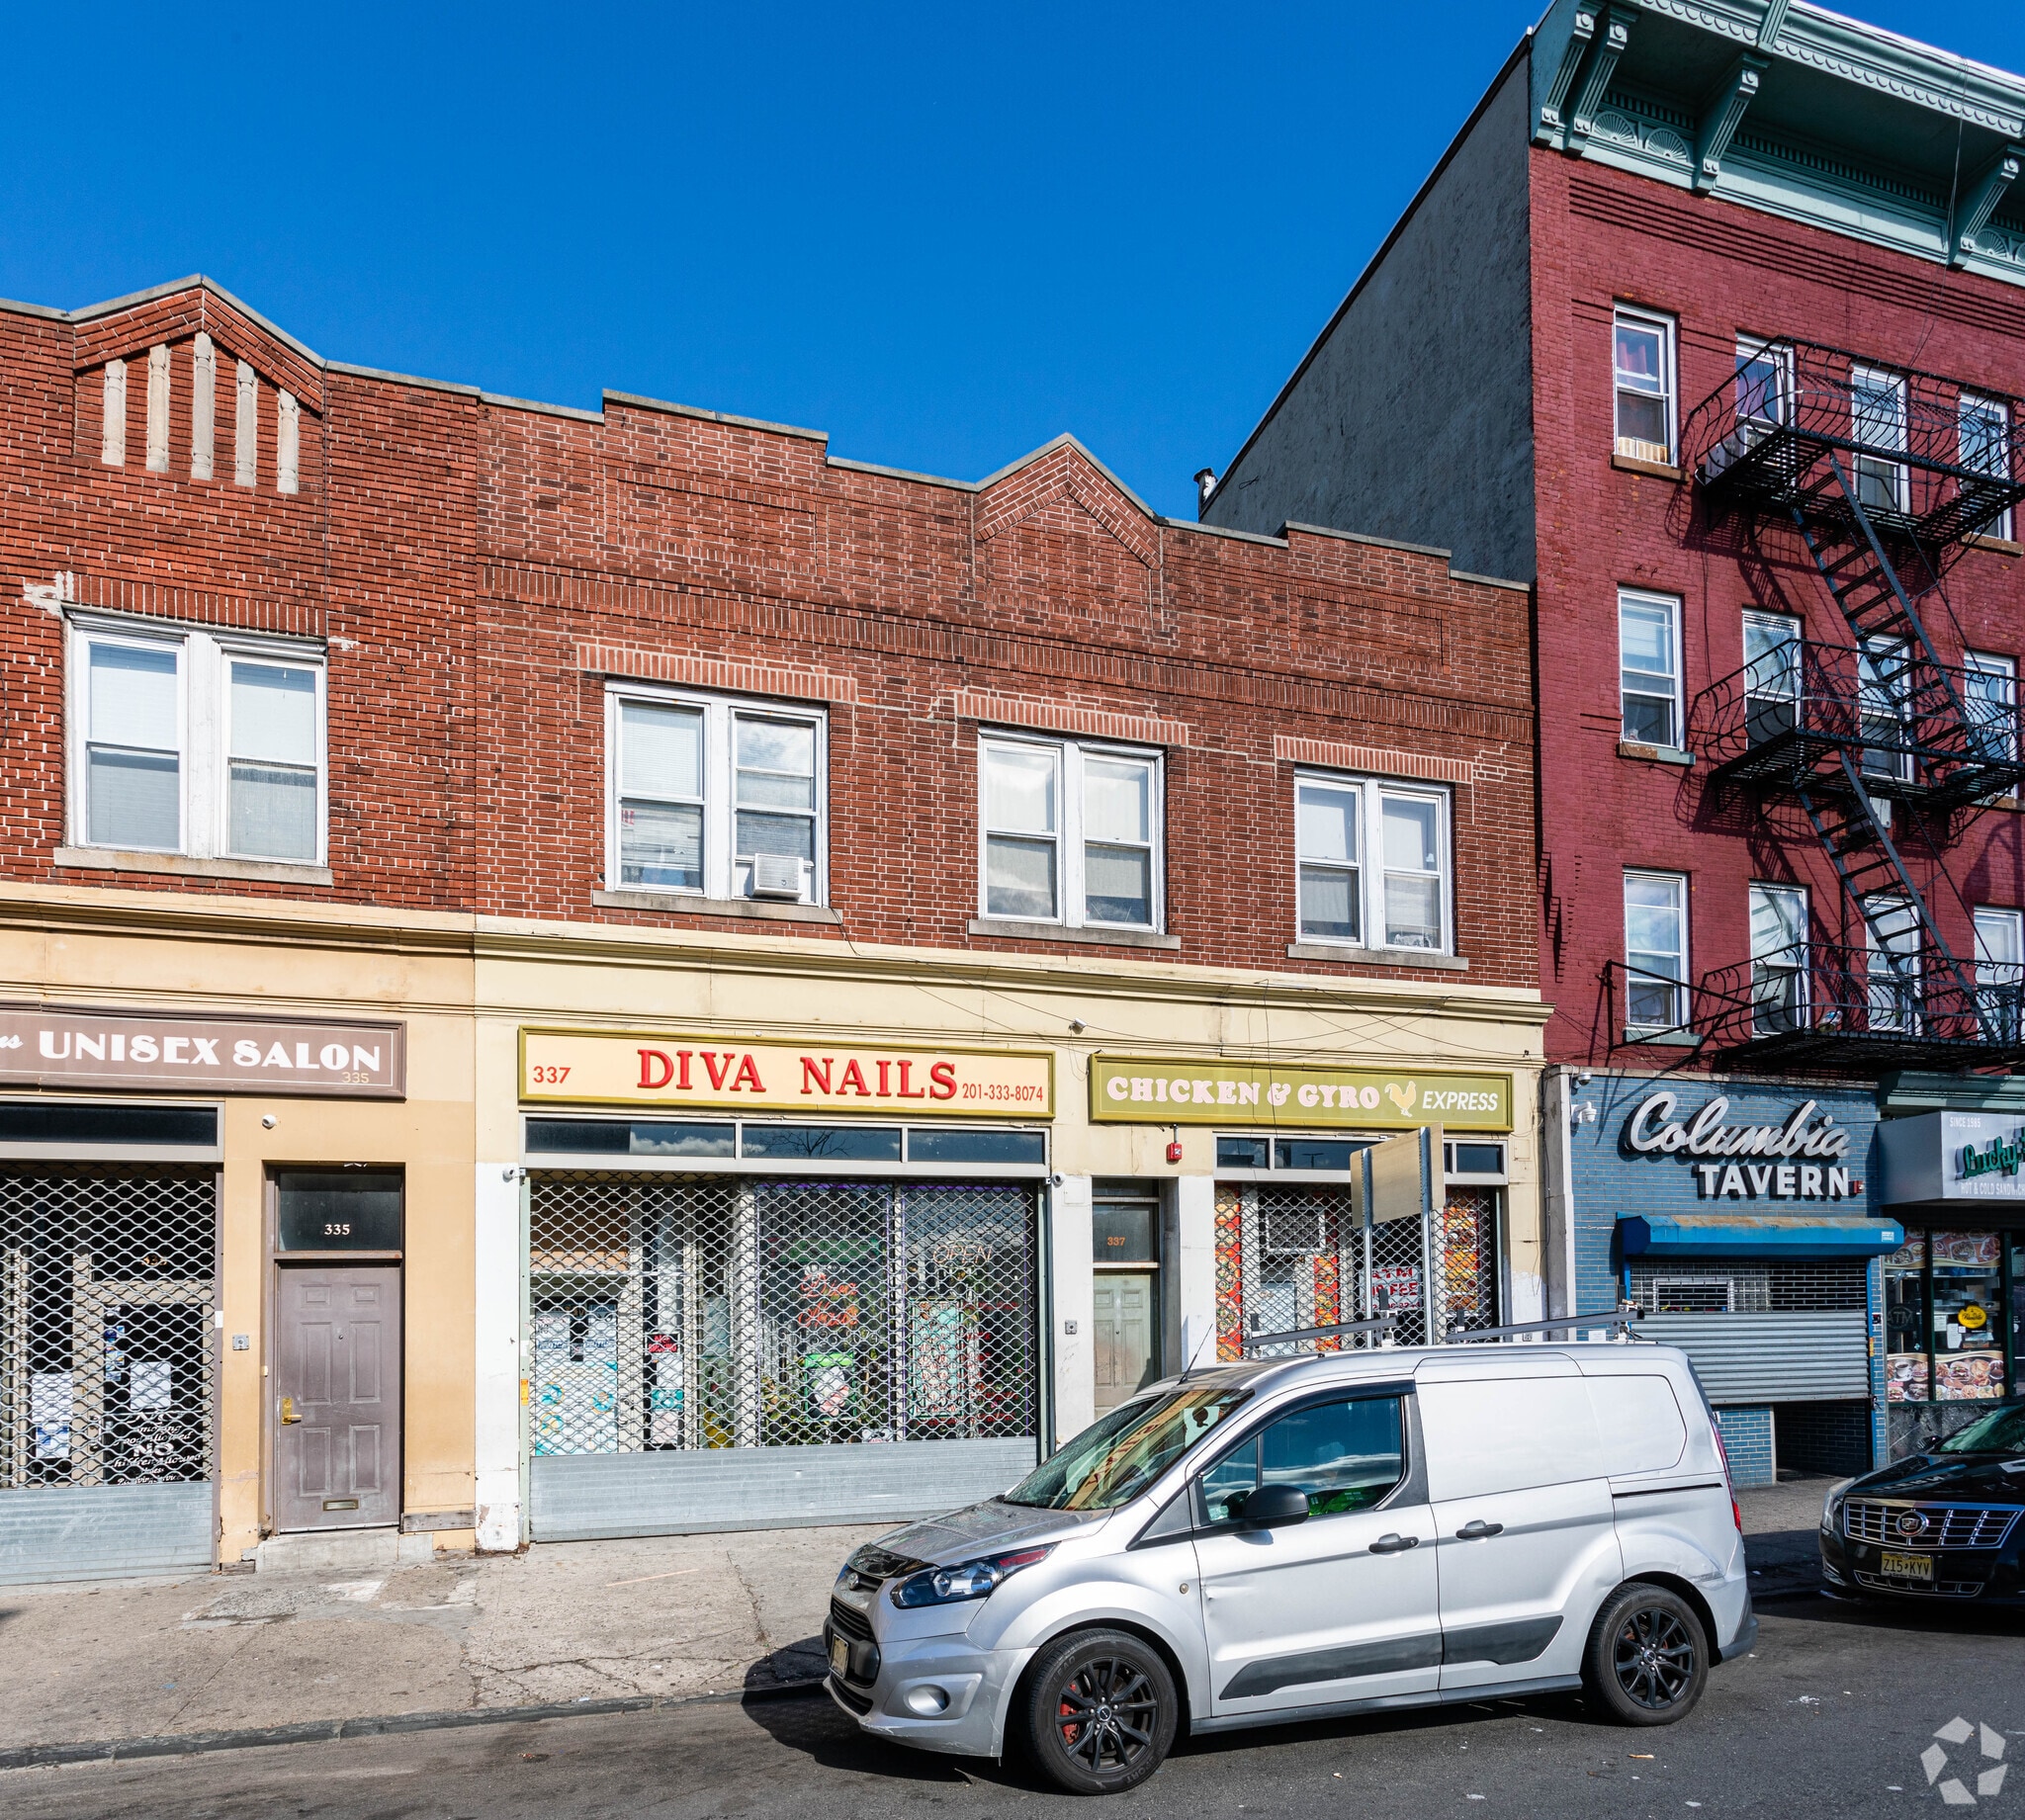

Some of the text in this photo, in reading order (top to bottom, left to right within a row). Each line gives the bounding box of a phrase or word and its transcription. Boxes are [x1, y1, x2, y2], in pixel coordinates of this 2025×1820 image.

[39, 1031, 220, 1066] UNISEX
[232, 1039, 381, 1072] SALON
[341, 1072, 370, 1083] 335
[532, 1066, 572, 1084] 337
[637, 1049, 957, 1100] DIVA NAILS
[961, 1083, 1044, 1102] 201-333-8074
[1106, 1076, 1499, 1112] CHICKEN & GYRO EXPRESS
[1627, 1090, 1852, 1158] Columbia
[1949, 1116, 1966, 1128] SINCE
[1697, 1164, 1849, 1197] TAVERN
[324, 1224, 351, 1236] 335
[1107, 1237, 1125, 1247] 337
[933, 1245, 993, 1263] OPEN
